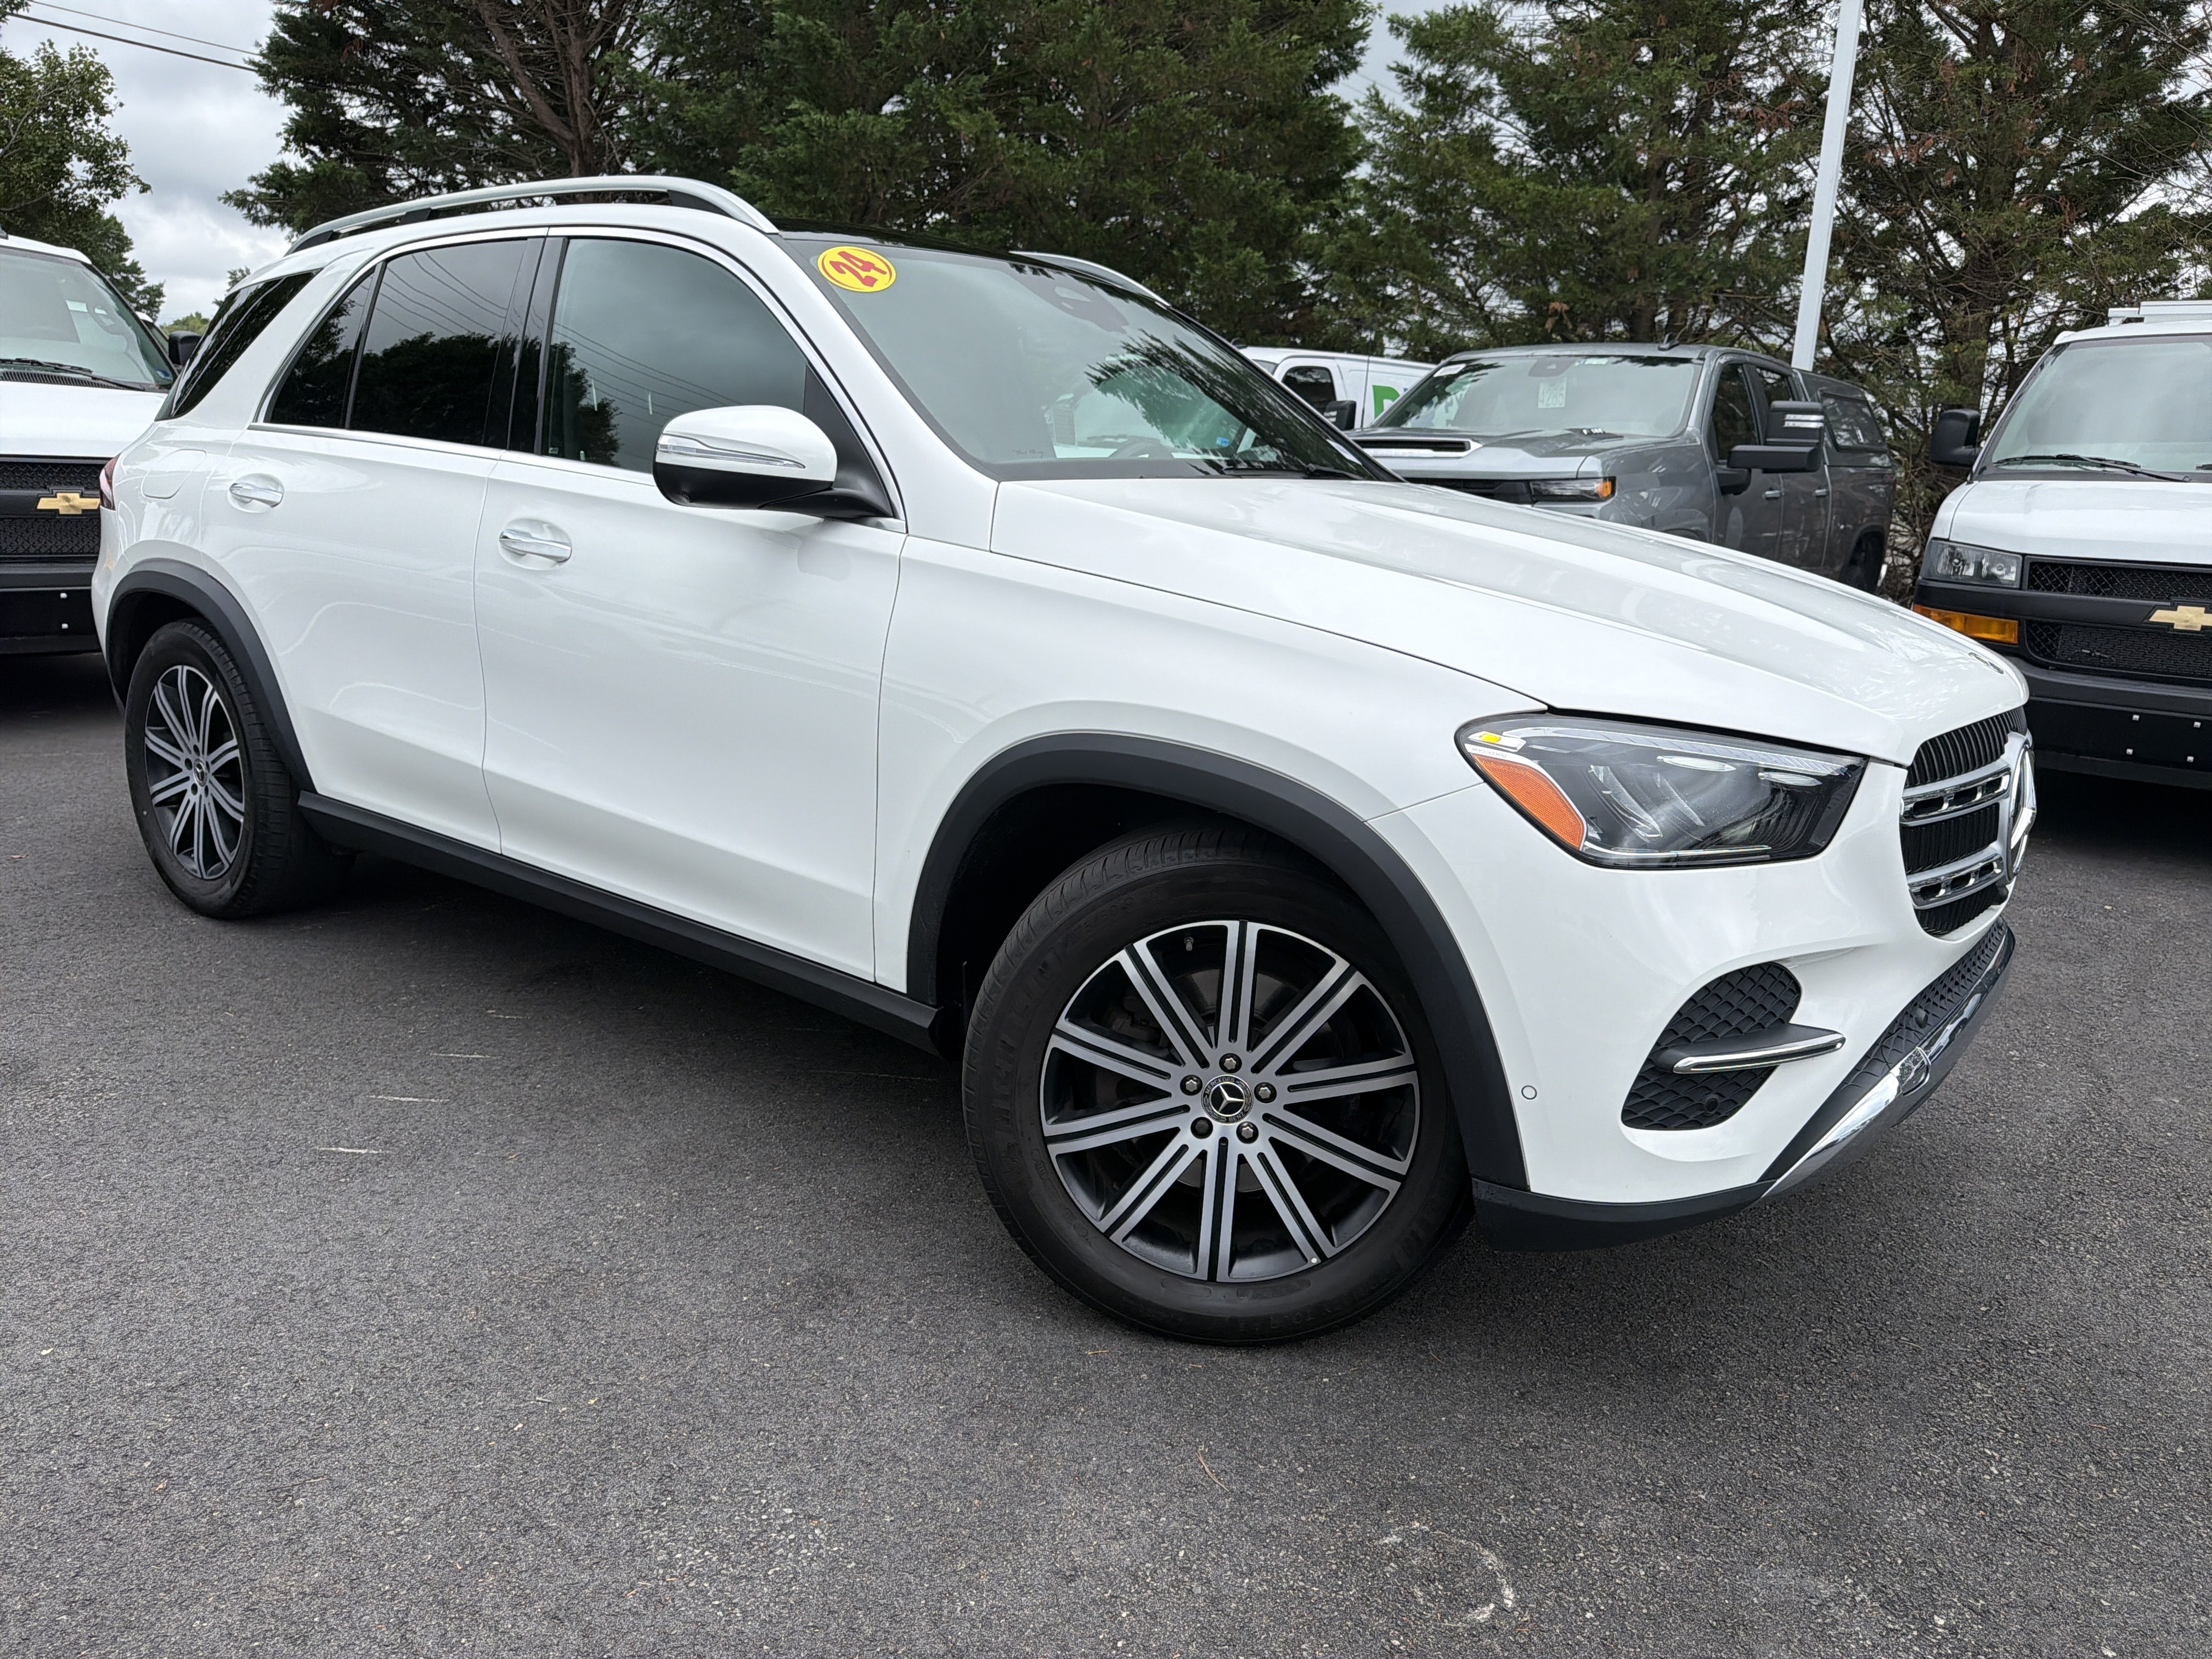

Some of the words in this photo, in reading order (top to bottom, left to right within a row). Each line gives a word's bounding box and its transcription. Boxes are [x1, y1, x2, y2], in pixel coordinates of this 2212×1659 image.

[829, 250, 888, 287] 24
[1205, 1077, 1235, 1094] MERCEDES
[1229, 1111, 1245, 1122] BENZ
